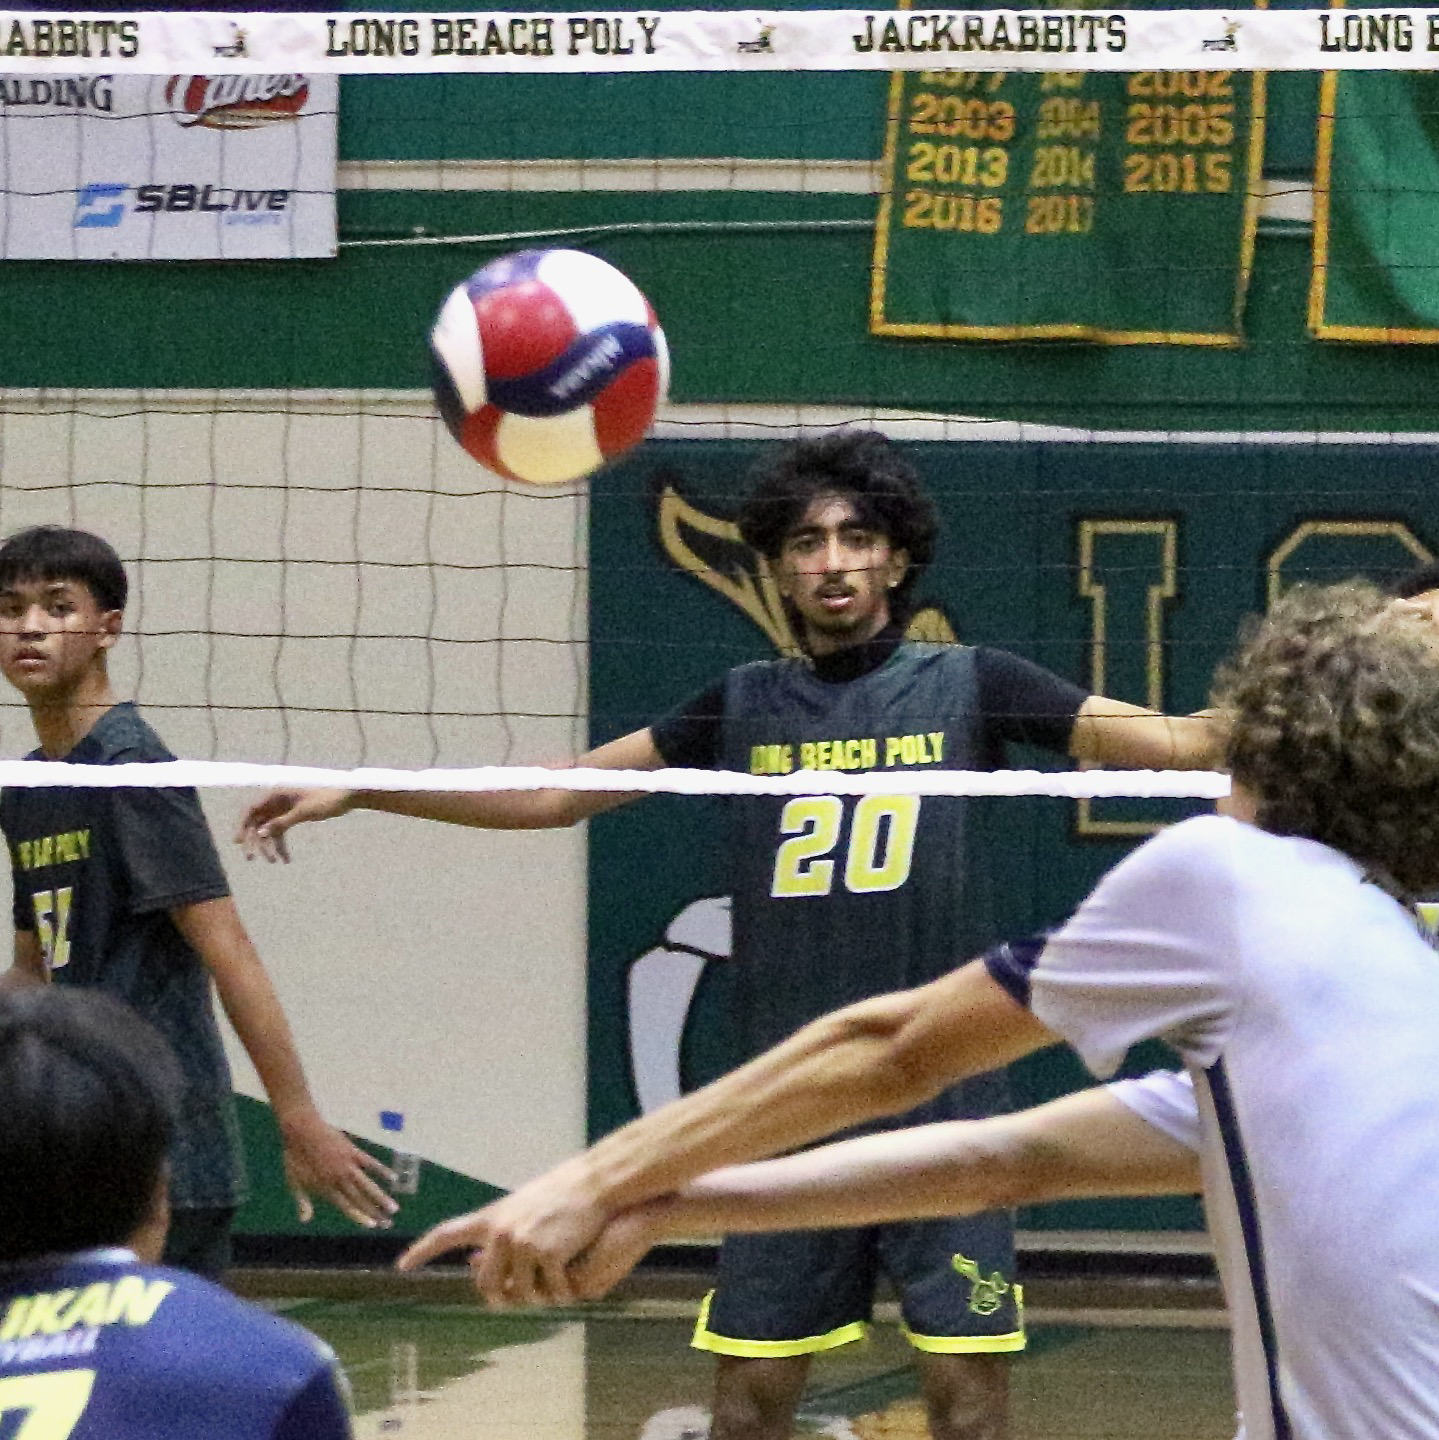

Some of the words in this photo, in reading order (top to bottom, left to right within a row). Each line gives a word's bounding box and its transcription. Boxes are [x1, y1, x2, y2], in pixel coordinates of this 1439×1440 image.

[325, 18, 421, 56] LONG
[431, 18, 555, 56] BEACH
[567, 17, 662, 55] POLY
[852, 14, 1128, 53] JACKRABBITS
[1318, 14, 1413, 53] LONG
[1125, 102, 1236, 146] 2005
[905, 142, 1009, 188] 2013
[1121, 152, 1233, 194] 2015
[902, 188, 1003, 234] 2016
[800, 738, 878, 771] BEACH
[885, 731, 946, 768] POLY
[770, 794, 922, 898] 20
